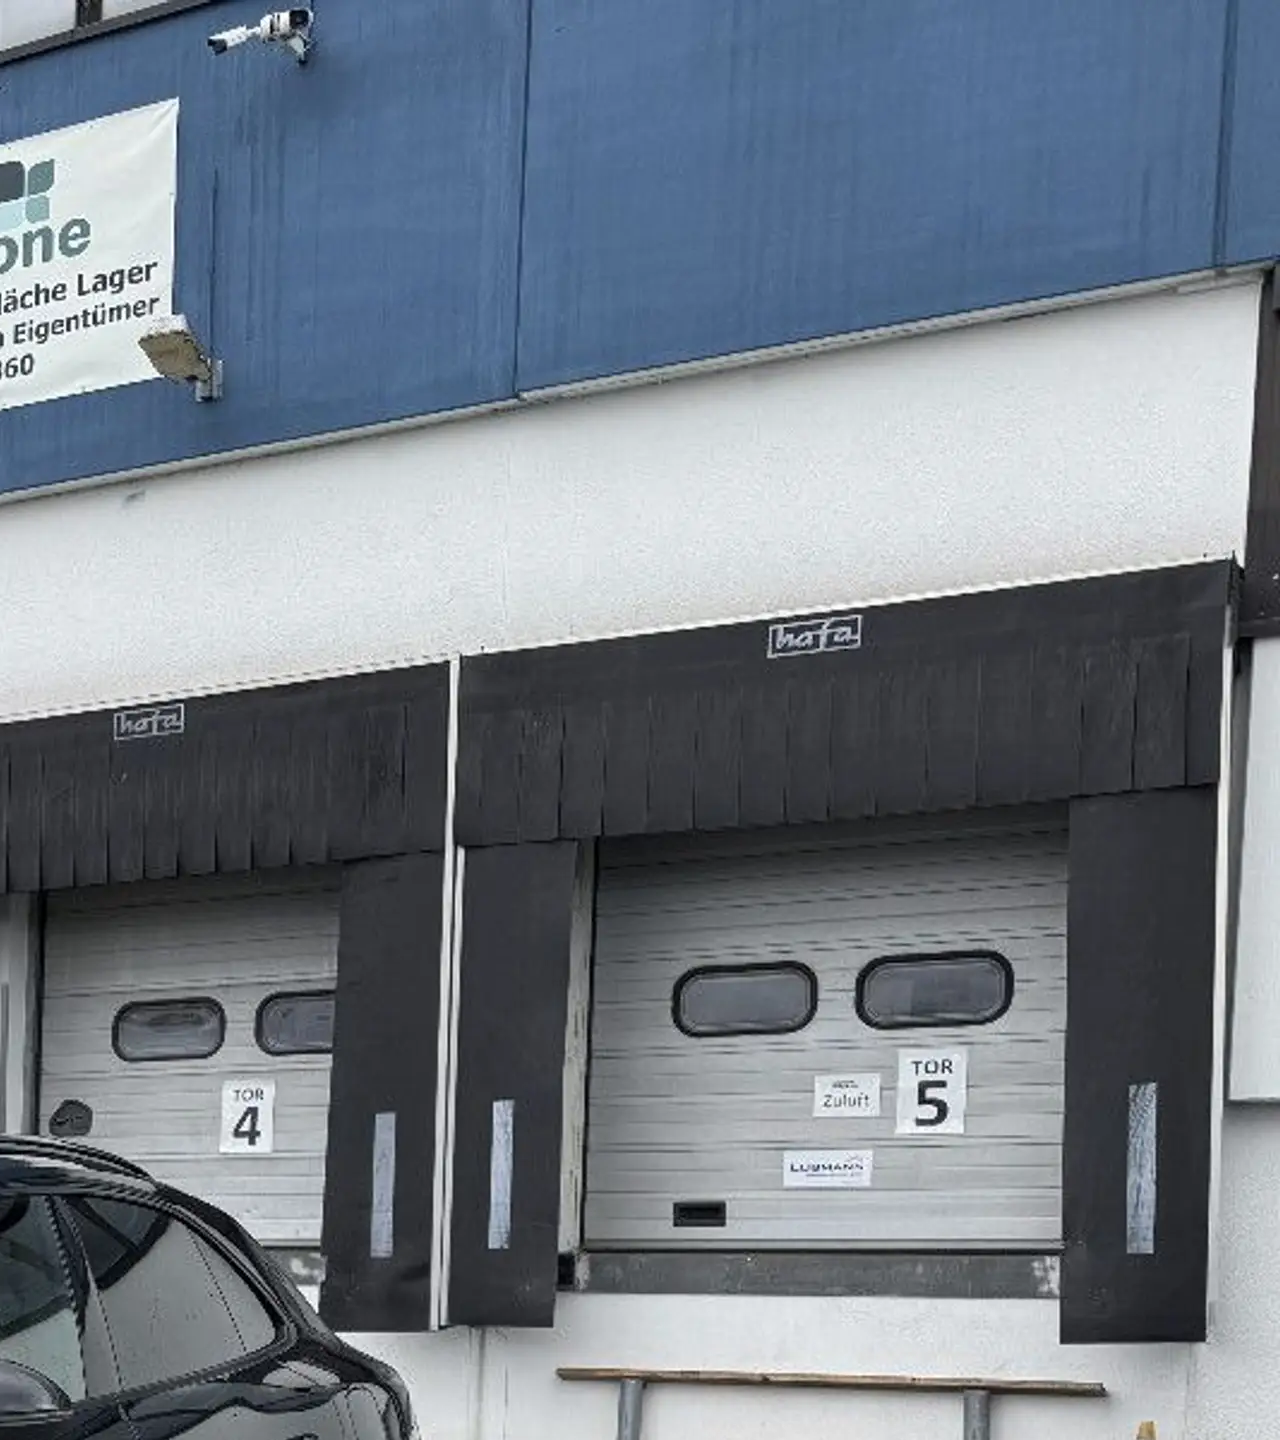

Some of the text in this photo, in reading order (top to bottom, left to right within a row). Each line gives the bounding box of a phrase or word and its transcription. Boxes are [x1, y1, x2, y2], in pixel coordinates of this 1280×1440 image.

[77, 262, 158, 296] Lager
[13, 297, 160, 345] Eigentümer
[910, 1058, 954, 1075] TOR
[233, 1087, 264, 1102] TOR
[914, 1080, 949, 1127] 5
[232, 1106, 261, 1147] 4
